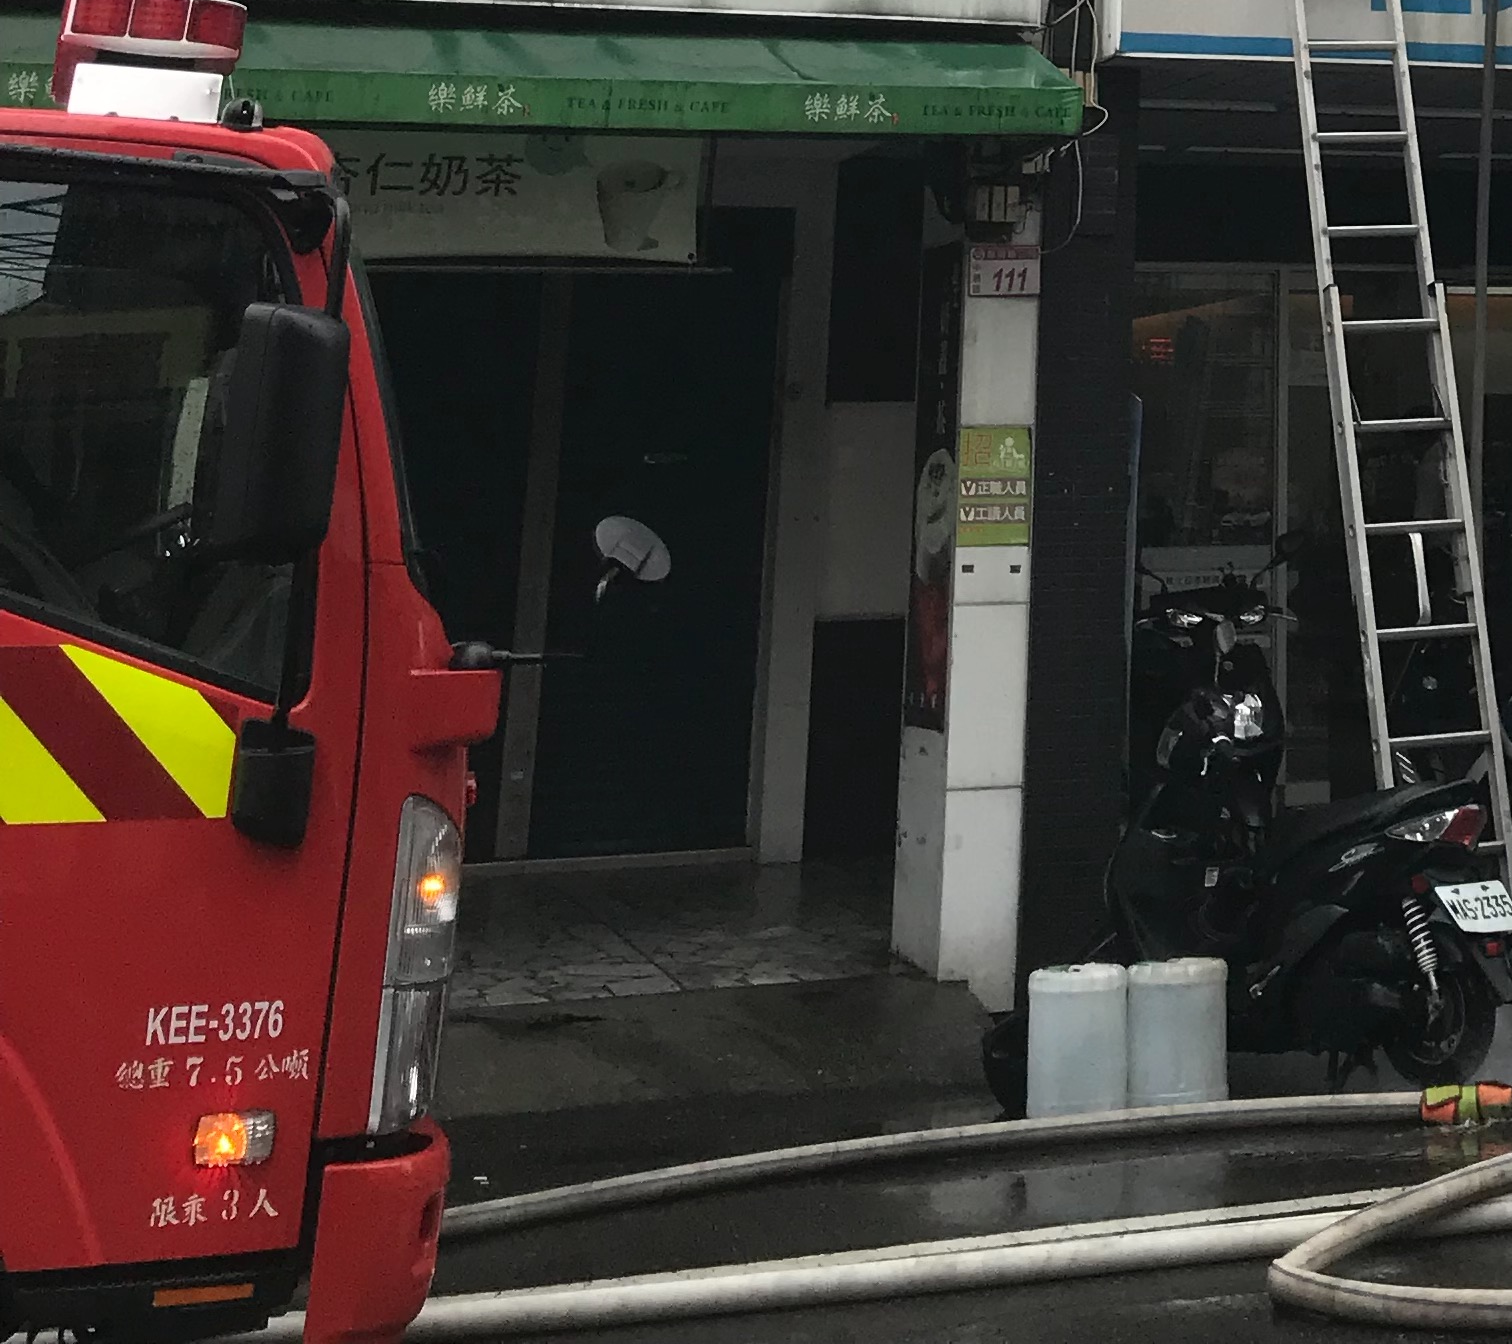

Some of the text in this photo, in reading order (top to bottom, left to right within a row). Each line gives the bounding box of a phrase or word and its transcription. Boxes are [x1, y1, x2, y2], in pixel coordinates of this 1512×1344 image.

[428, 83, 523, 116] 樂鮮茶
[805, 92, 893, 124] 樂鮮茶
[992, 266, 1028, 292] 111
[145, 999, 285, 1046] KEE-3376
